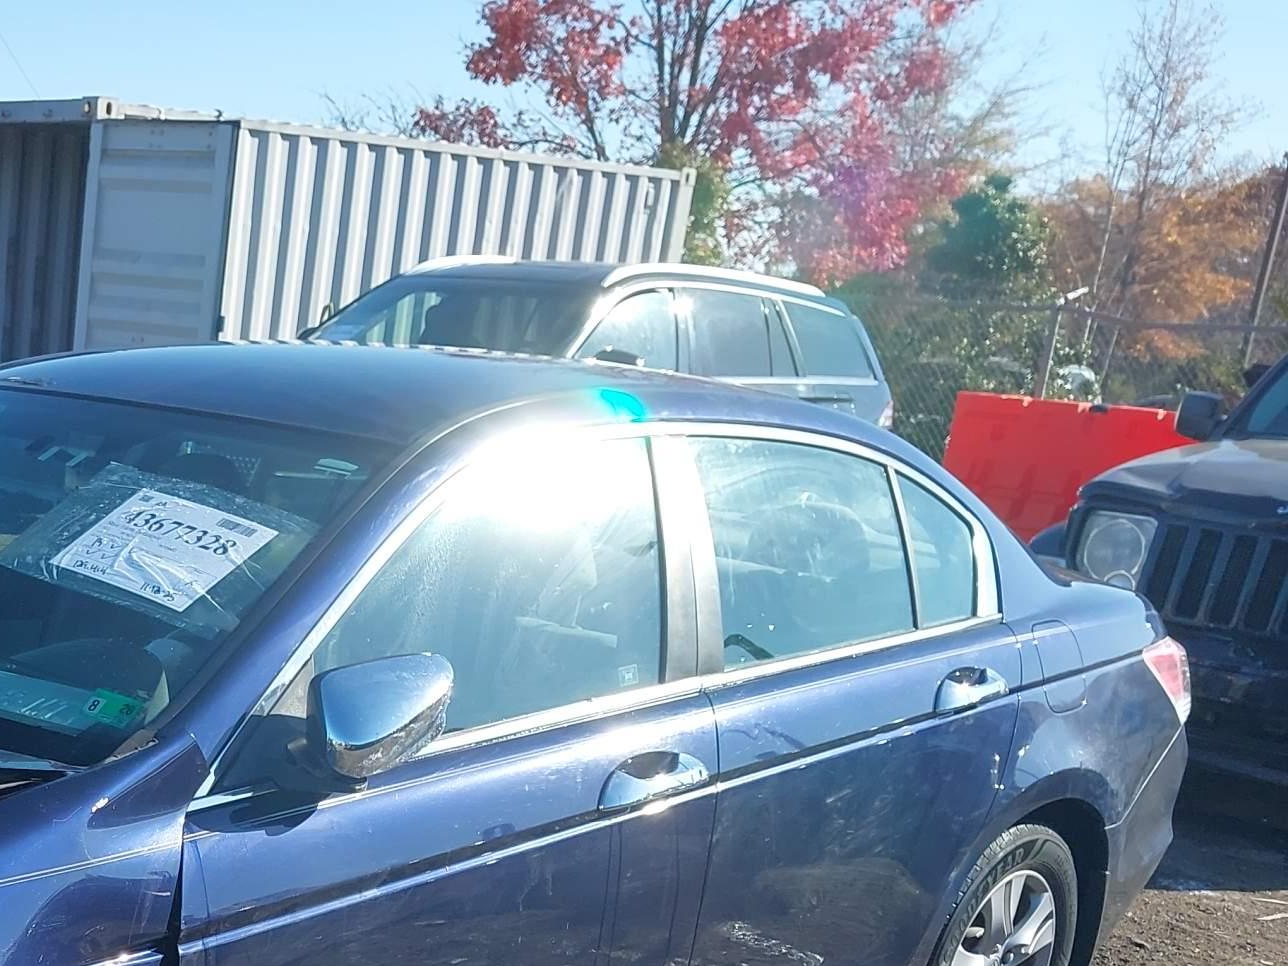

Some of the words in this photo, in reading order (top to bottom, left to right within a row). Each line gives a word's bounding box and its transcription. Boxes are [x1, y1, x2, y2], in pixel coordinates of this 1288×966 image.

[120, 508, 238, 556] 43677328
[87, 699, 101, 712] 8
[943, 847, 1026, 964] GOODYEAR
